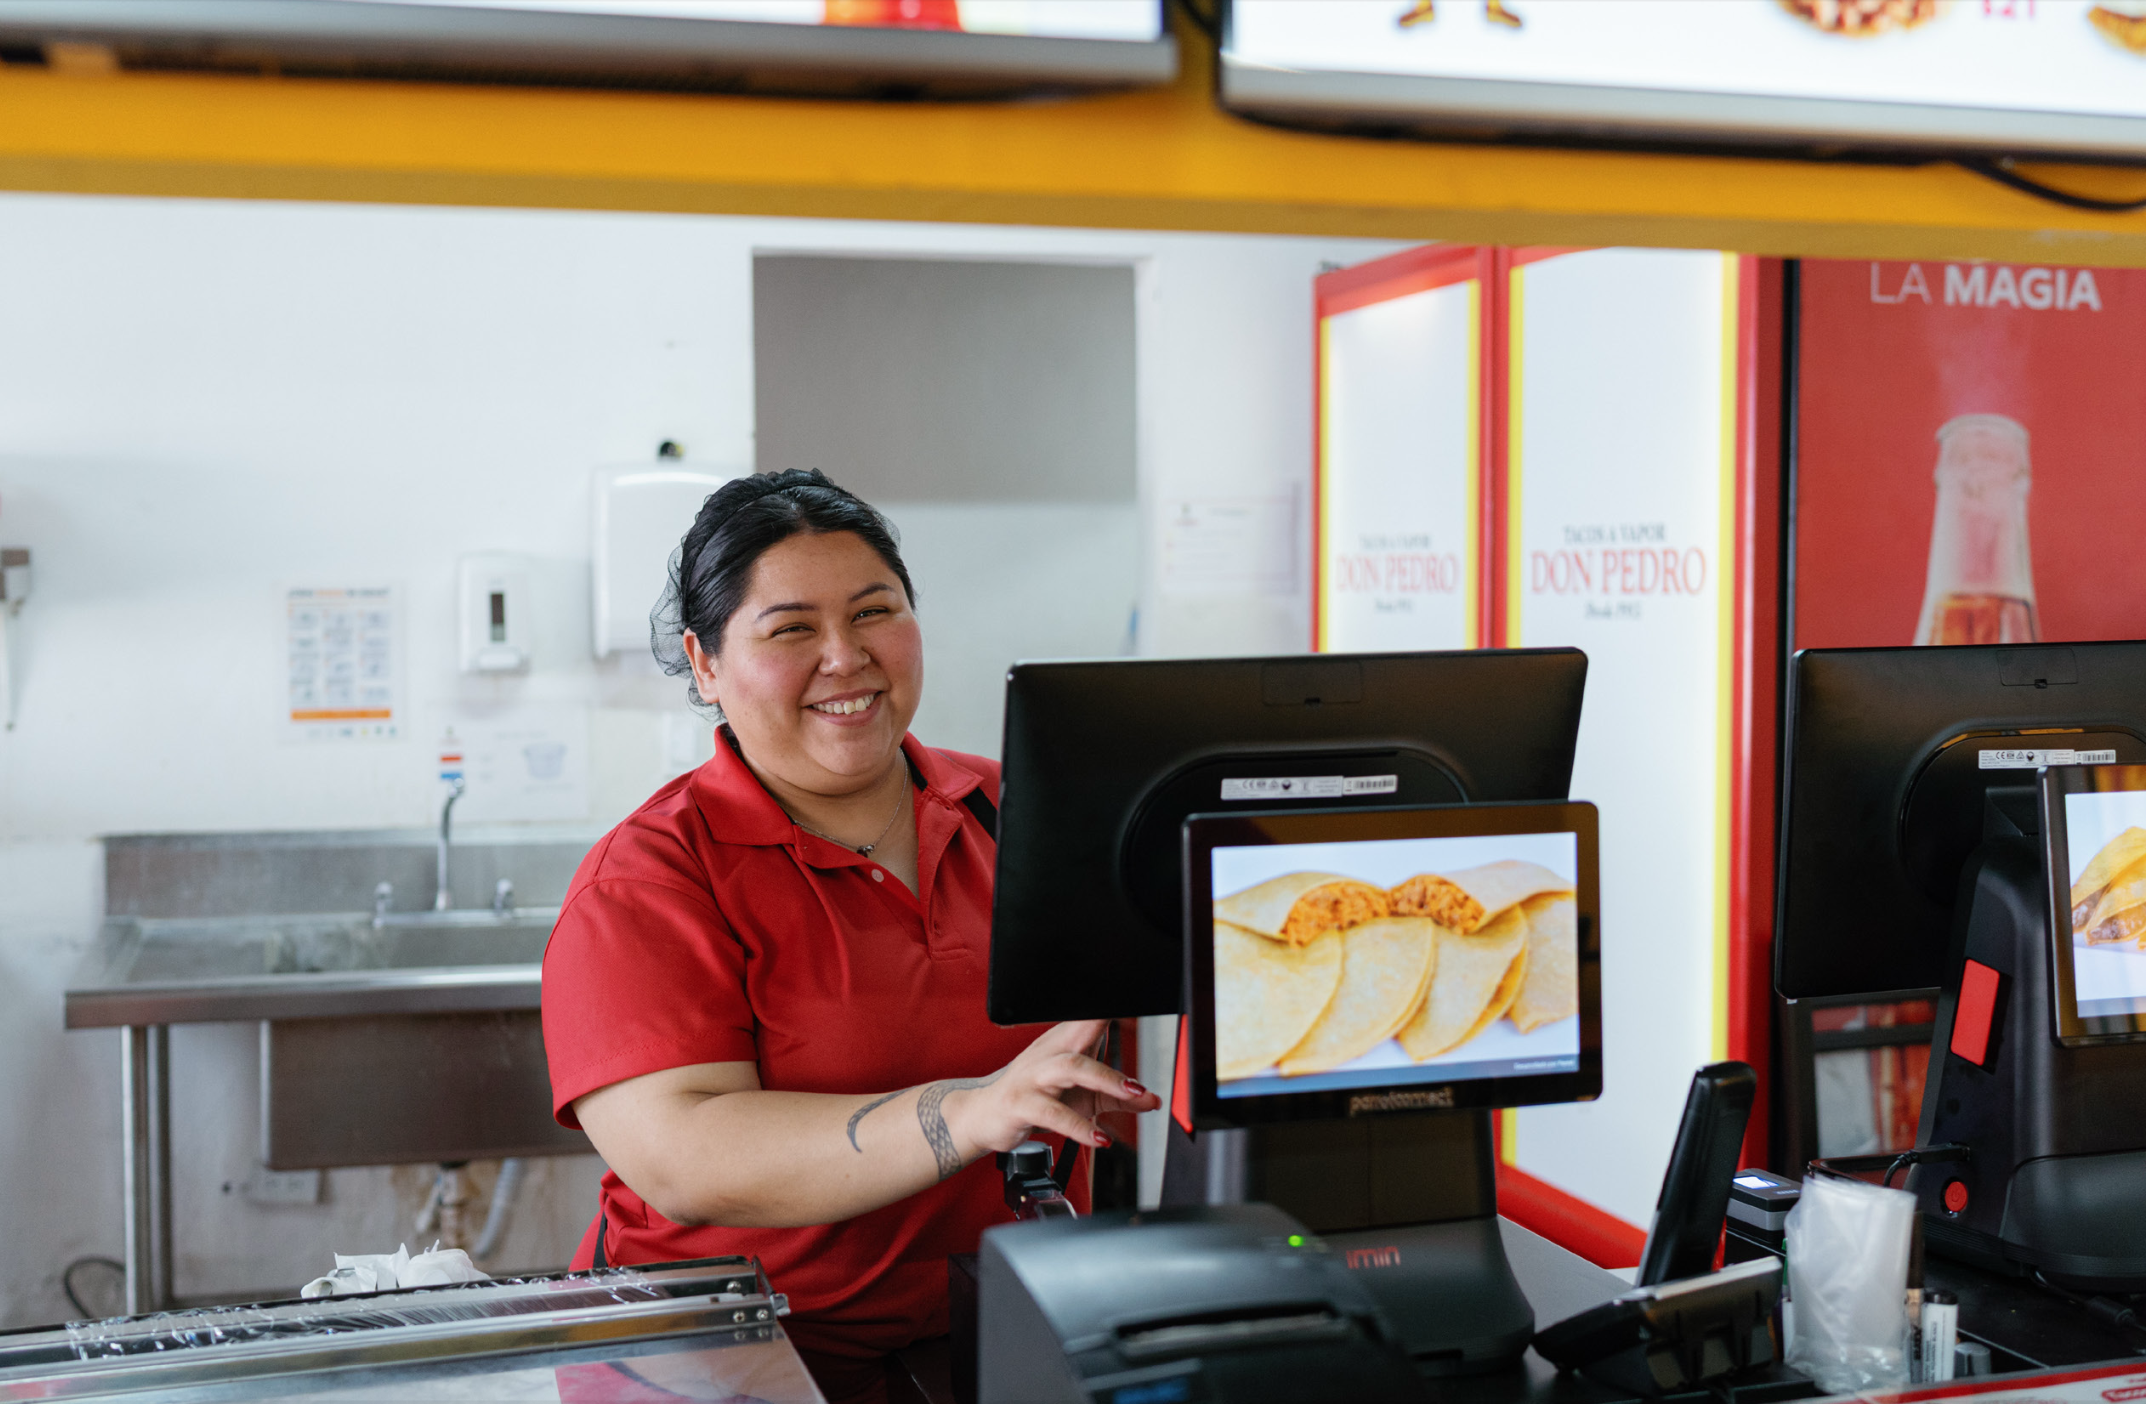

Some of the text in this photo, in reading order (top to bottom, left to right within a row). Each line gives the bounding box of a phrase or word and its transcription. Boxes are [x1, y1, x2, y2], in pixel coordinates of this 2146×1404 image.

[1870, 262, 2103, 312] LA MAGIA
[1336, 552, 1460, 596] DON PEDRO
[1531, 546, 1707, 595] DON PEDRO
